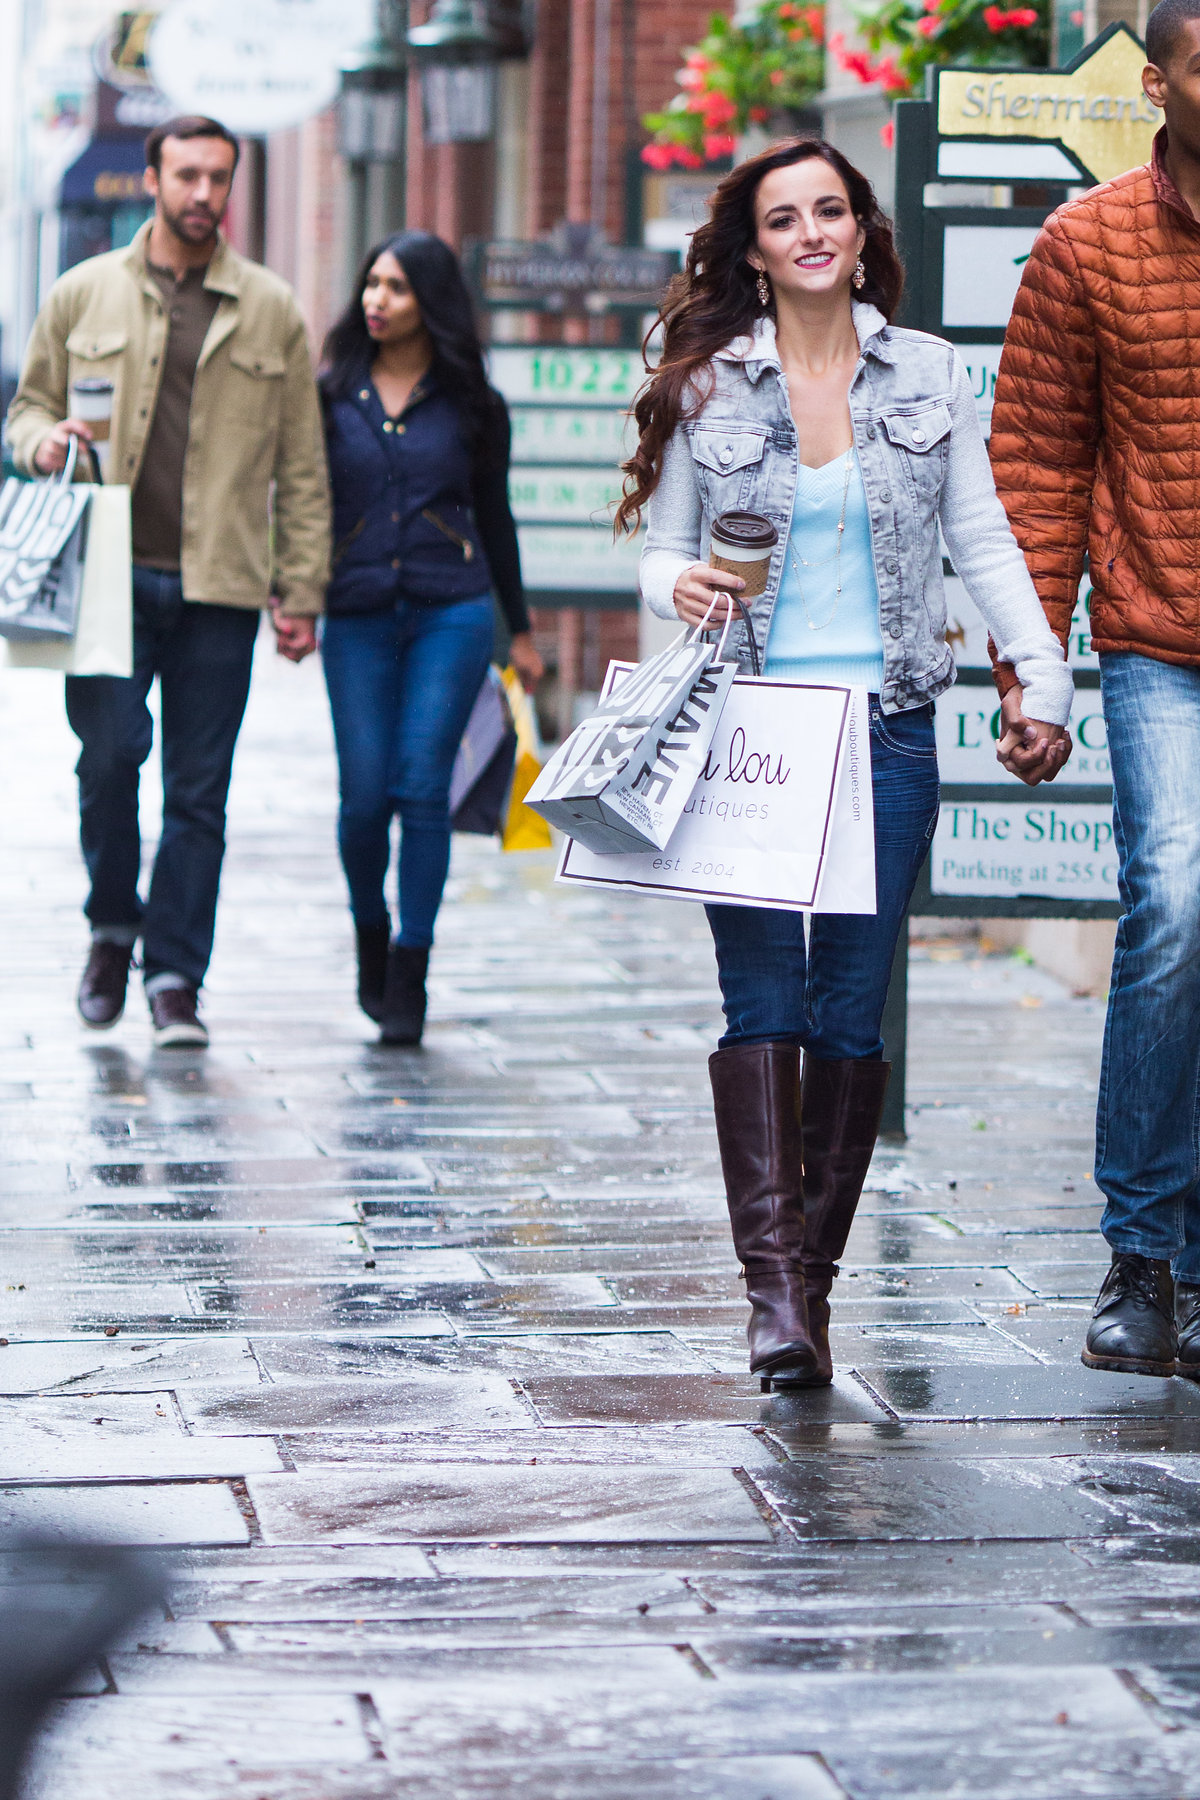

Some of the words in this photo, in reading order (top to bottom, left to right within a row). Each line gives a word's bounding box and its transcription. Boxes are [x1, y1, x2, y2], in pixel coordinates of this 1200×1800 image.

[530, 353, 630, 392] 1022
[631, 664, 726, 806] WAVE
[724, 726, 791, 785] lou
[683, 794, 769, 822] utiques
[942, 806, 1010, 840] The
[652, 857, 684, 873] est.
[691, 861, 736, 879] 2004
[942, 858, 1023, 887] Parking
[1029, 861, 1049, 882] at
[1056, 861, 1095, 884] 255
